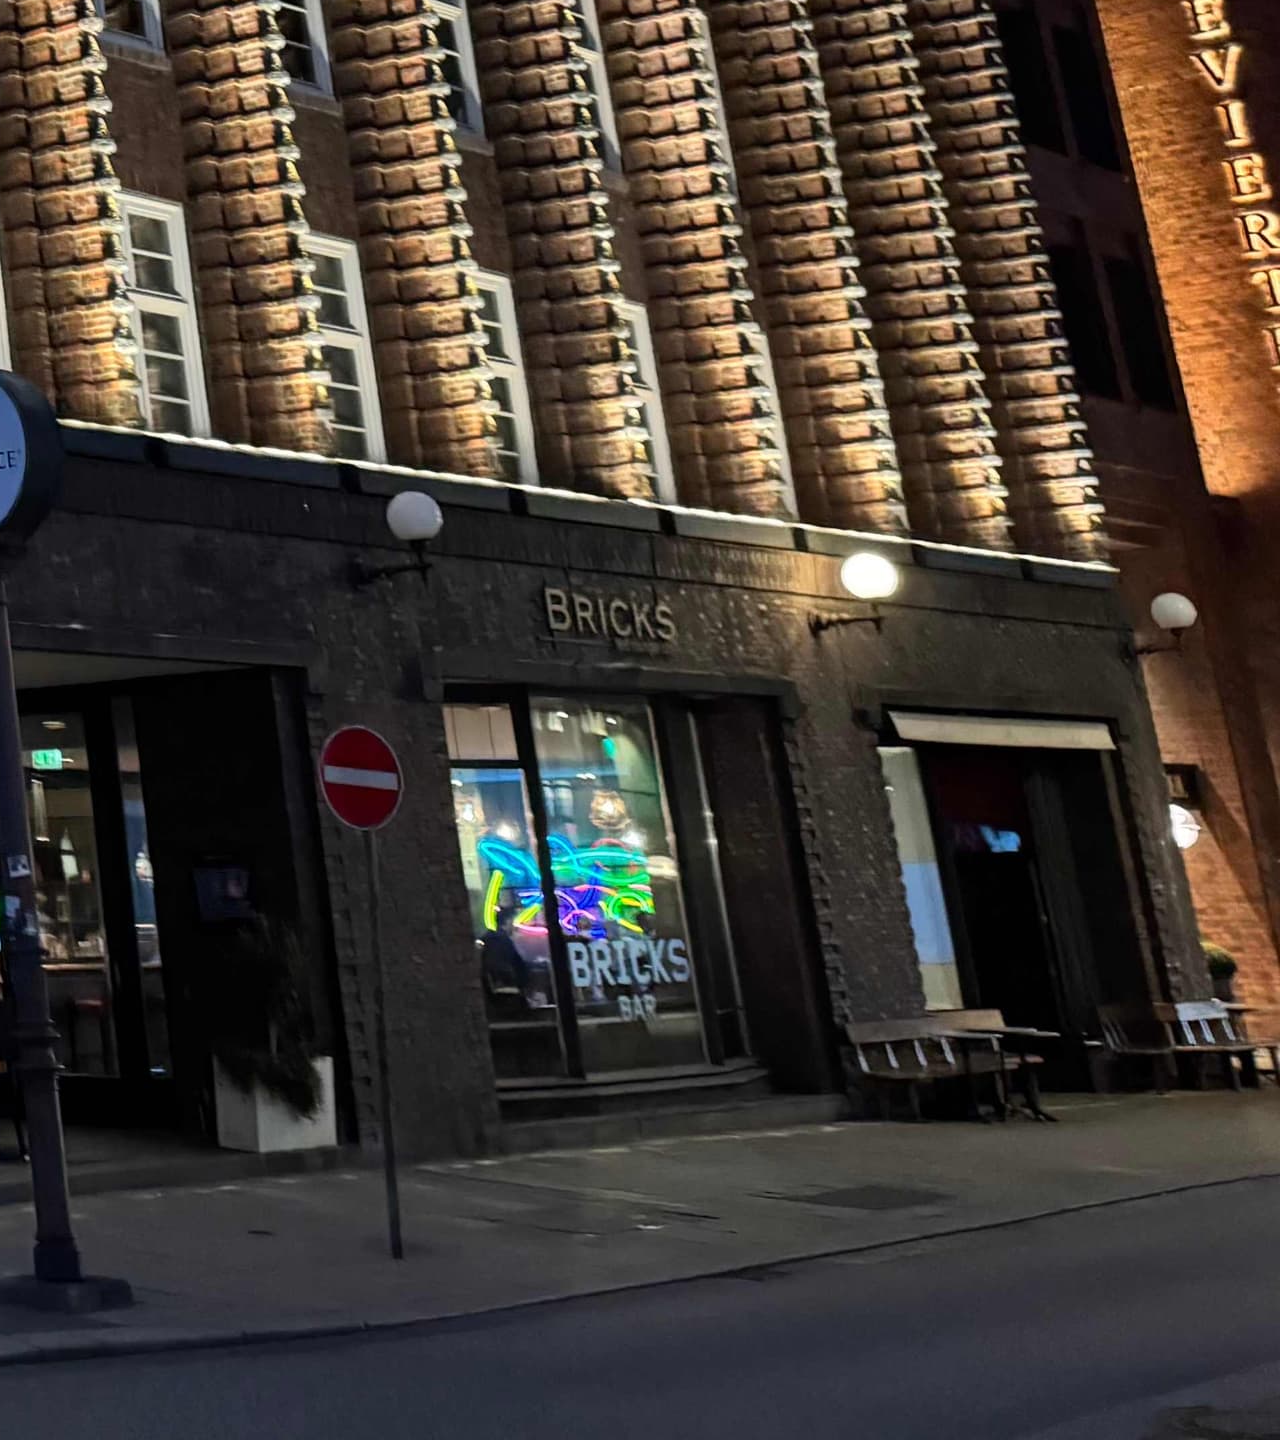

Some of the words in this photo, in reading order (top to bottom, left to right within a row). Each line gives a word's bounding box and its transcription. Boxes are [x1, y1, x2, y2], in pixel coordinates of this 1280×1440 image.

[543, 586, 677, 642] BRICKS
[566, 936, 690, 988] BRICKS
[617, 993, 658, 1023] BAR
